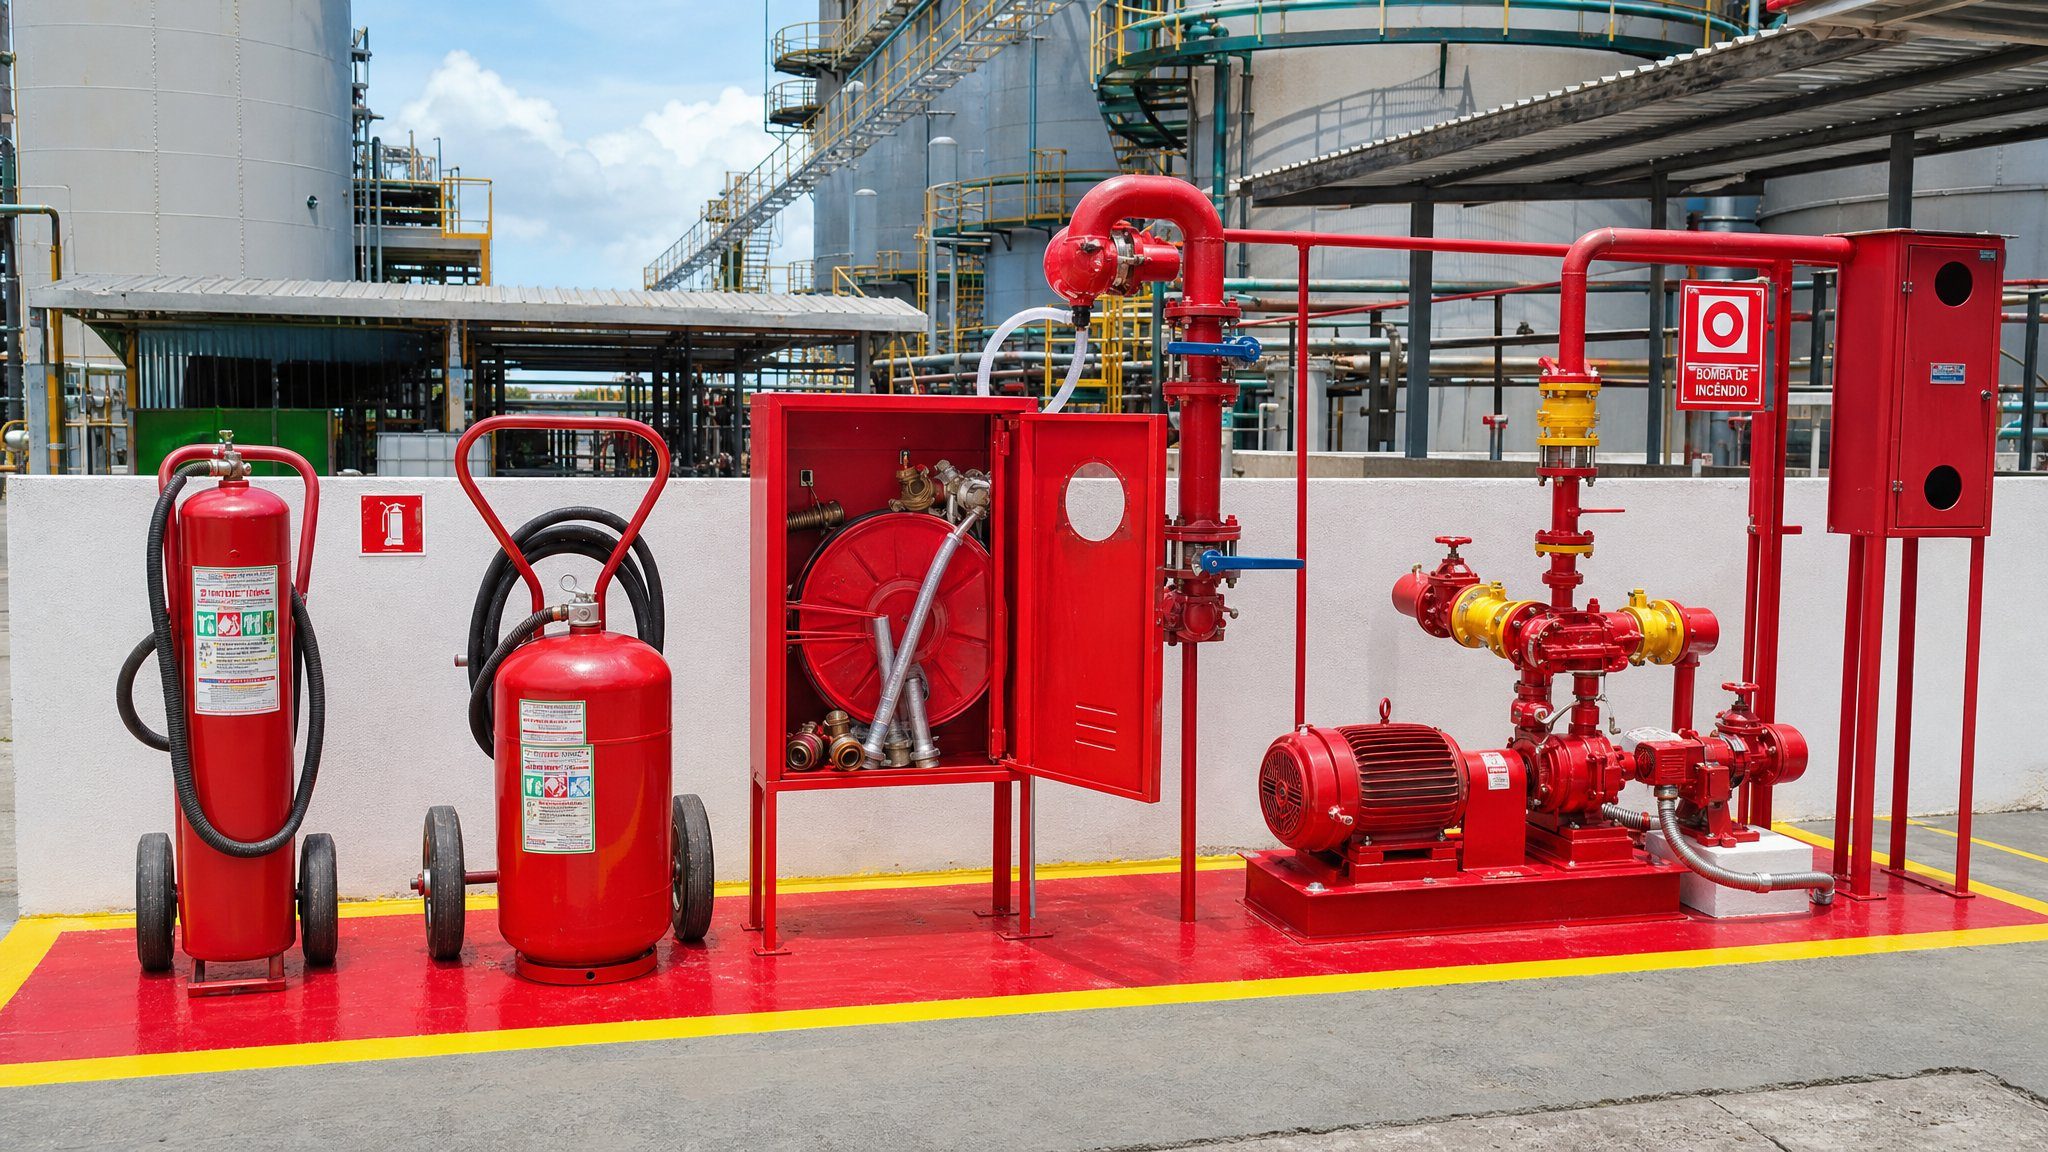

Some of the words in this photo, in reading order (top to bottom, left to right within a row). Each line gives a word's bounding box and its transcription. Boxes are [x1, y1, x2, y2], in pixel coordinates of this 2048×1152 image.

[1696, 368, 1733, 381] BOMBA
[1735, 369, 1749, 381] DE
[1695, 382, 1748, 397] INCÊNDIO
